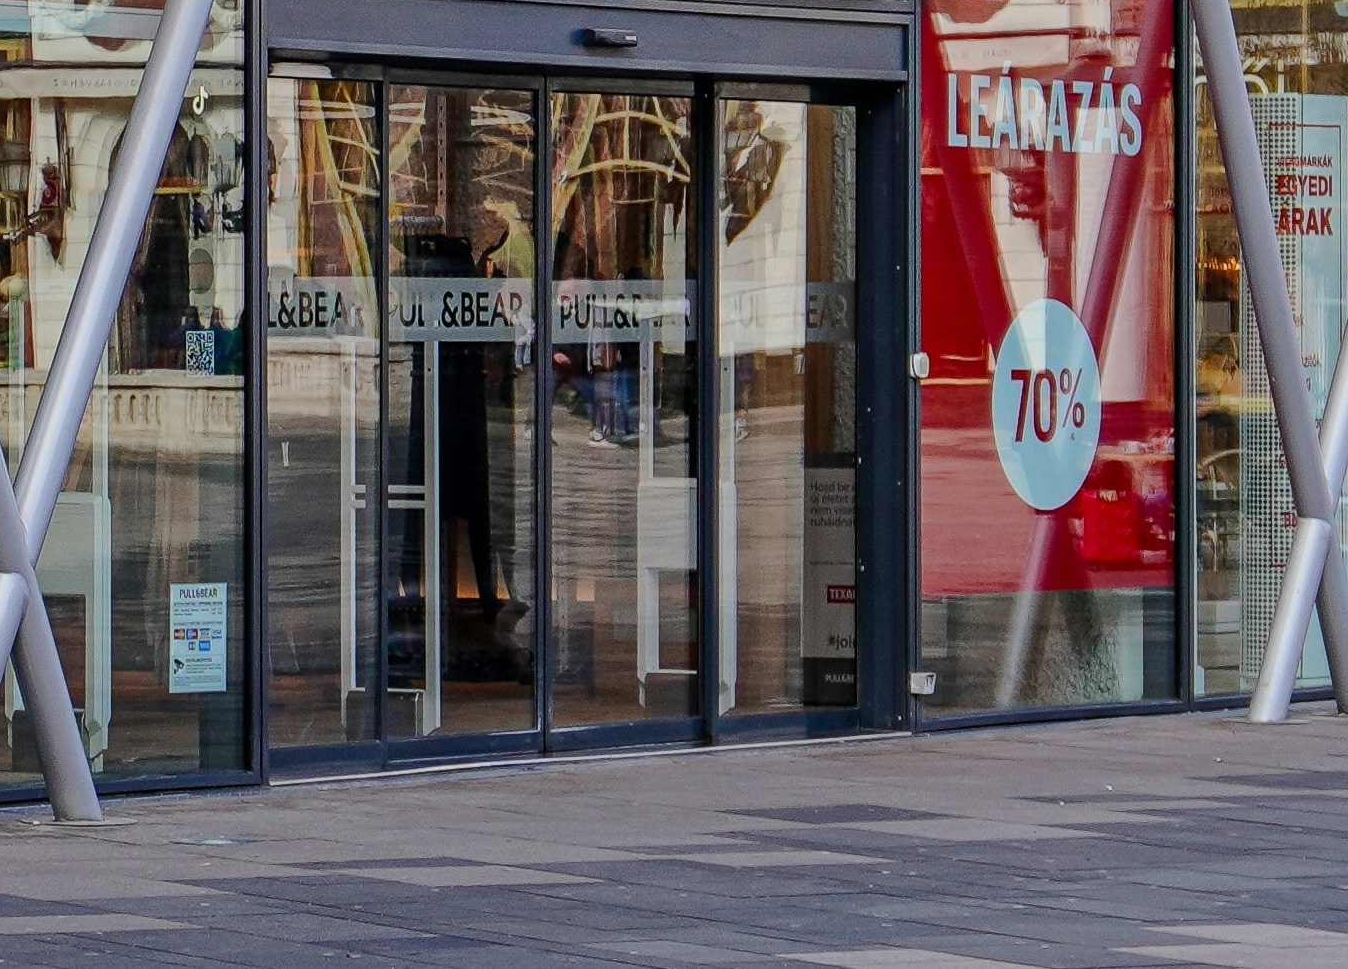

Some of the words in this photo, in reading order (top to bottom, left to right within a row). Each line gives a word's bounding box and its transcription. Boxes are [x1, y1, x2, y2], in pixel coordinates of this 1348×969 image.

[947, 60, 1143, 157] LEÁRAZÁS
[1276, 201, 1333, 236] ÁRAK
[1010, 367, 1086, 443] 70%
